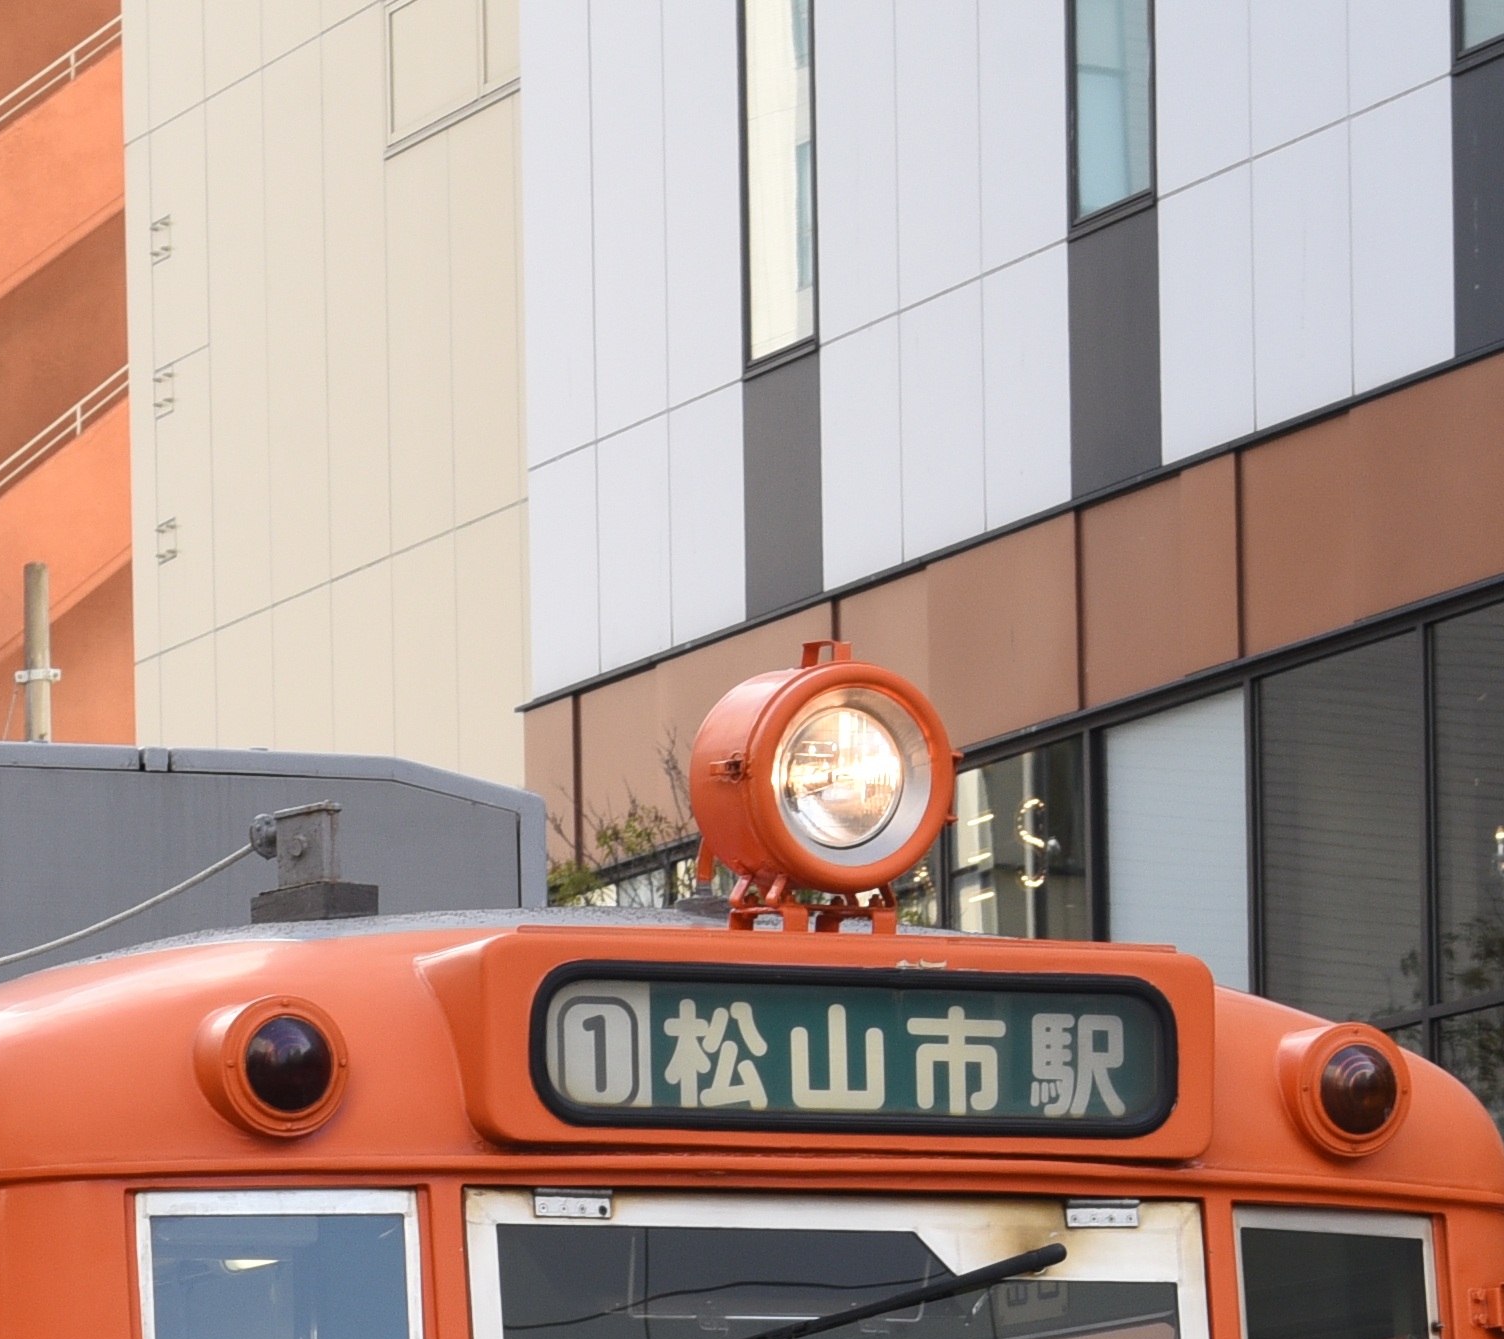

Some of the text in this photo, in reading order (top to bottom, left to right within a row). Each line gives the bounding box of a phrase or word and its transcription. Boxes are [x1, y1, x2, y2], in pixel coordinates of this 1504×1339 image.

[582, 997, 1126, 1118] 1 松山市駅
